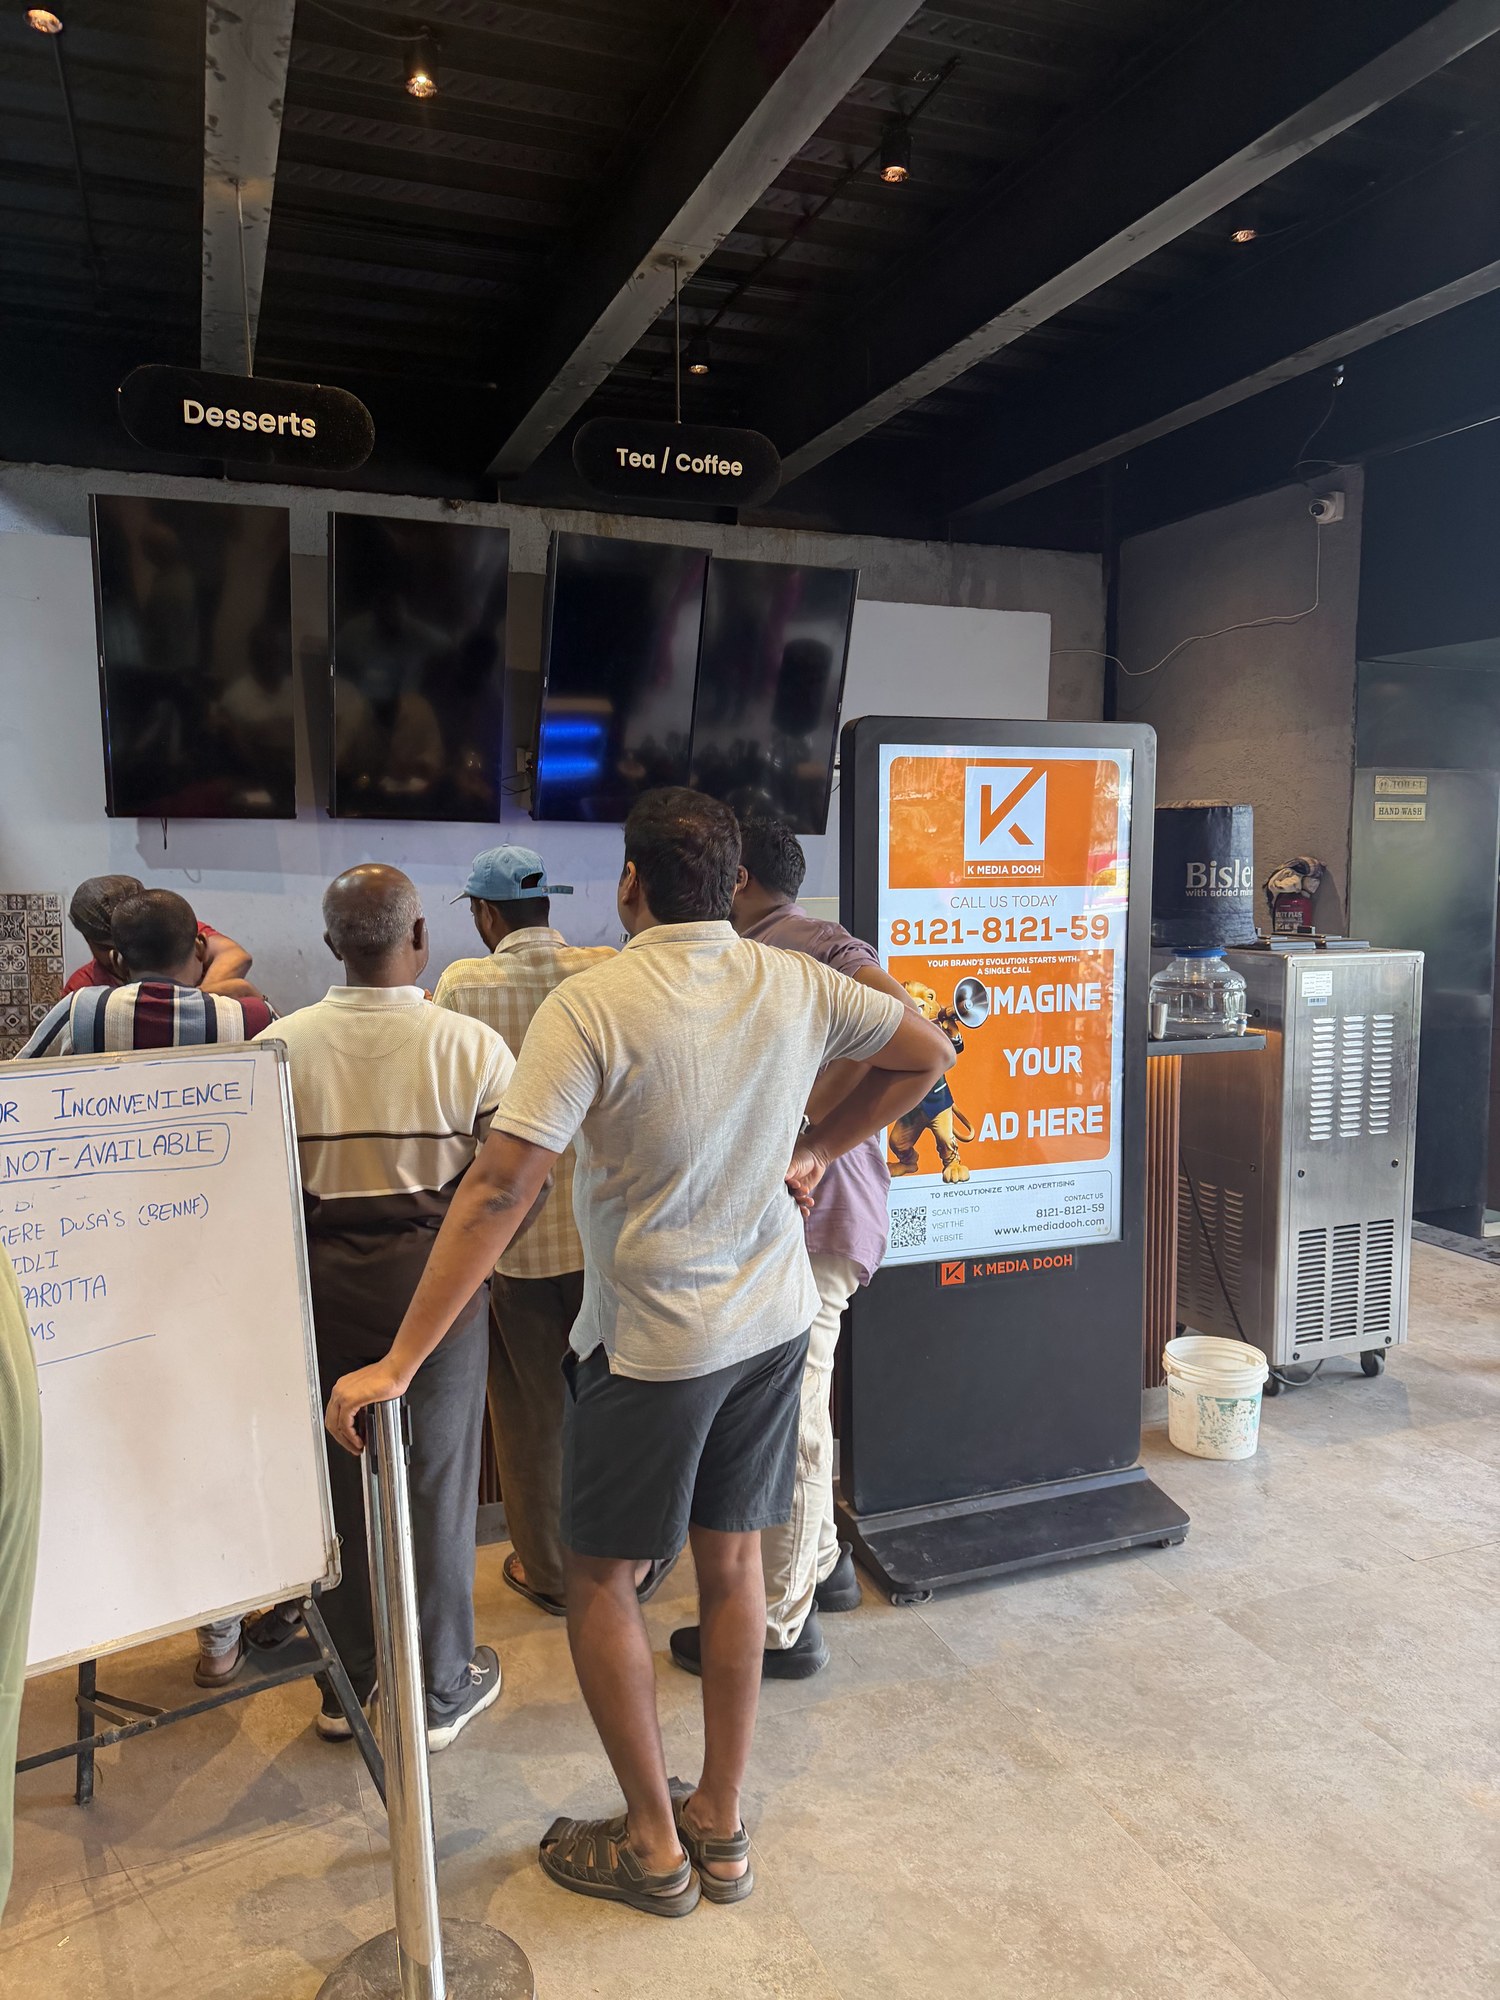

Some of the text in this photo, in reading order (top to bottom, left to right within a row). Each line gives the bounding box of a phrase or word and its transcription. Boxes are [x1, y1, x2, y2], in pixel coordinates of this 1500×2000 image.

[183, 399, 317, 439] Desserts
[616, 446, 743, 477] Tea / Coffee
[1391, 780, 1424, 790] TOILET
[1378, 807, 1423, 816] HAND WASH
[966, 863, 1041, 875] K MEDIA DOOH
[1186, 889, 1208, 897] with
[1210, 888, 1239, 897] added
[950, 894, 1058, 909] CALL US TODAY
[889, 914, 1110, 946] 8121-8121-59
[927, 960, 949, 968] YOUR
[950, 958, 984, 967] BRAND'S
[985, 957, 1028, 966] EVOLUTION
[1029, 956, 1057, 964] STARTS
[984, 967, 1011, 975] SINGLE
[1012, 966, 1031, 974] CALL
[1003, 1045, 1082, 1077] YOUR
[978, 1105, 1104, 1142] AD HERE
[943, 1186, 1003, 1198] REVOLUTIONIZE
[1005, 1184, 1025, 1192] YOUR
[1027, 1180, 1075, 1190] ADVERTISING
[1064, 1193, 1094, 1202] CONTACT
[931, 1205, 980, 1217] SCAN THIS TO
[1036, 1203, 1105, 1218] 8121-8121-59
[932, 1219, 964, 1230] VISIT THE
[994, 1218, 1105, 1236] www.kmediadooh.com
[932, 1233, 964, 1243] WEBSITE
[973, 1254, 1073, 1277] K MEDIA DOOH
